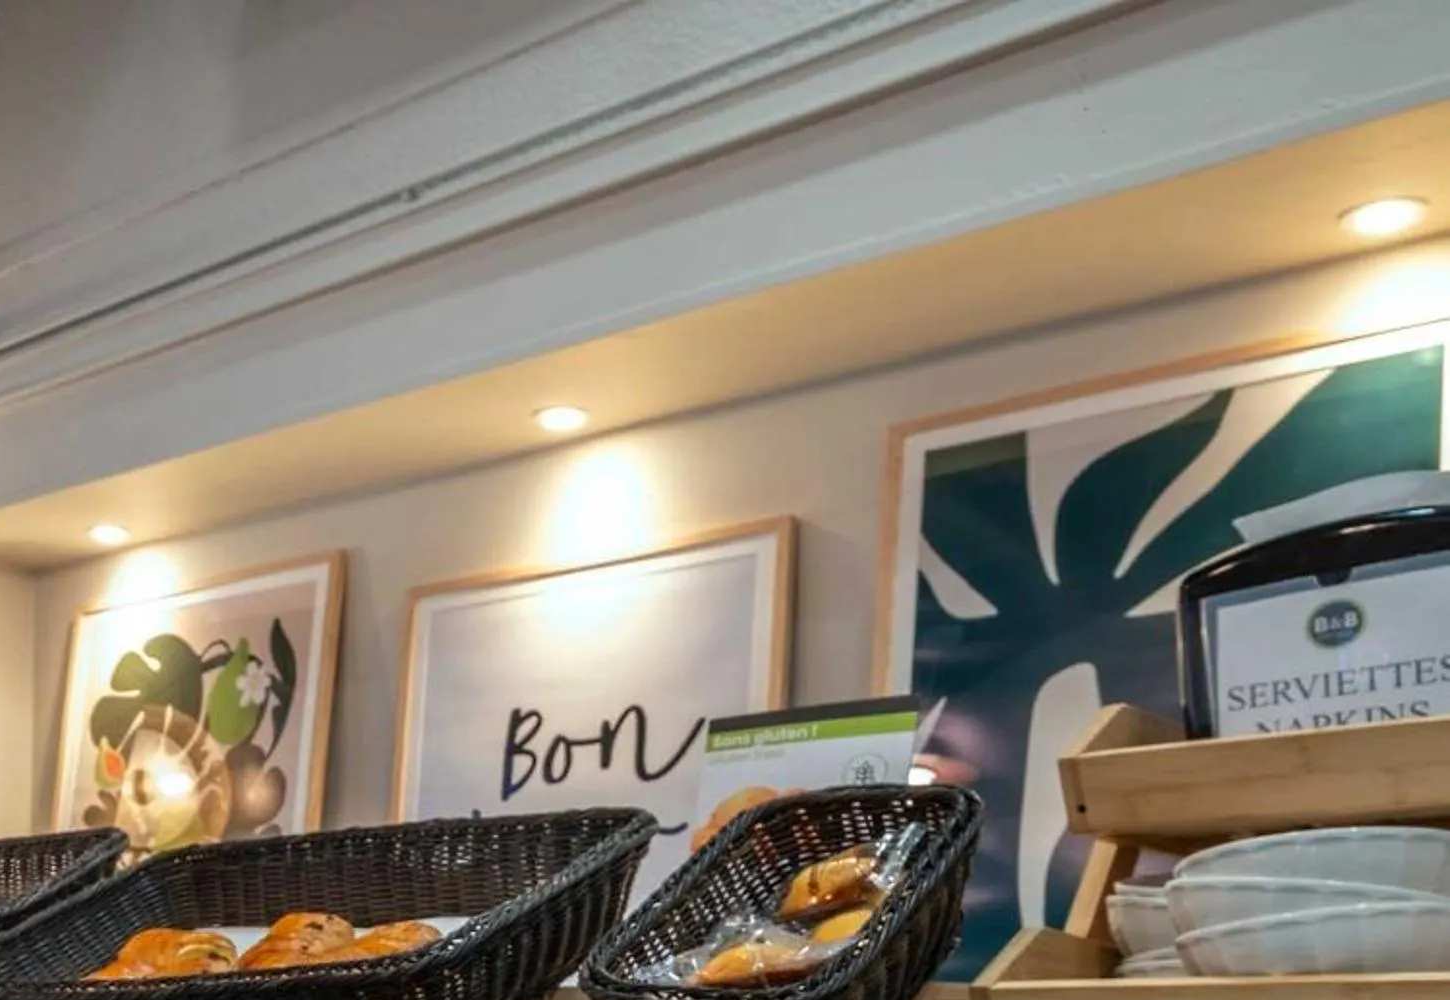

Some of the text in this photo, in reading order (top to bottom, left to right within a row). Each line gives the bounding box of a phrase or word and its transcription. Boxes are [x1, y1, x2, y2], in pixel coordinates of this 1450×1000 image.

[1313, 611, 1359, 633] B&B
[1227, 655, 1450, 713] SERVIETTES
[501, 704, 705, 802] Bon
